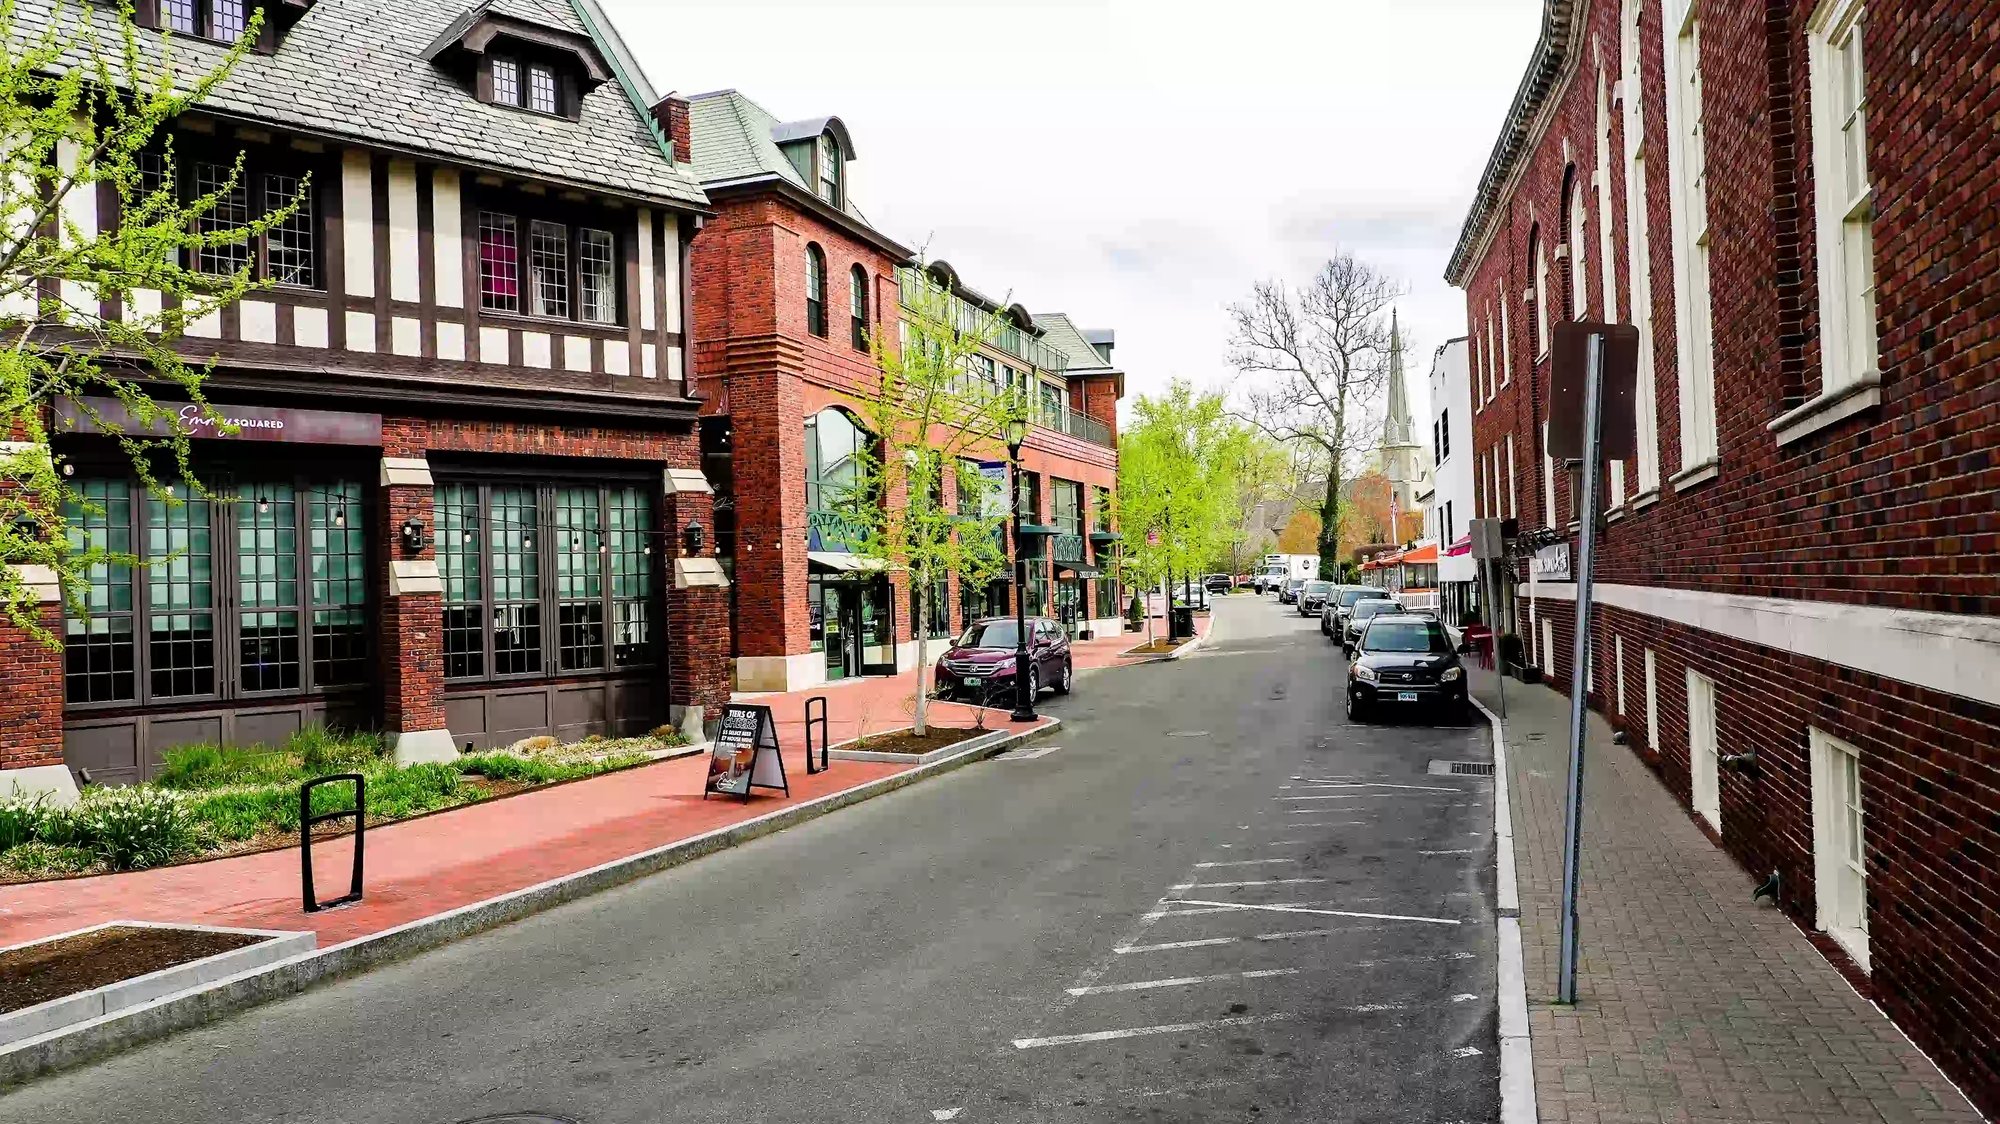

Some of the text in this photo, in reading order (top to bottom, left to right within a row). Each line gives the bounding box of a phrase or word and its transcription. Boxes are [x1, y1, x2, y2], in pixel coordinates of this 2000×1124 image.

[232, 419, 284, 429] SQUARED
[729, 710, 756, 719] TIERS OF
[723, 717, 757, 729] CHEERS
